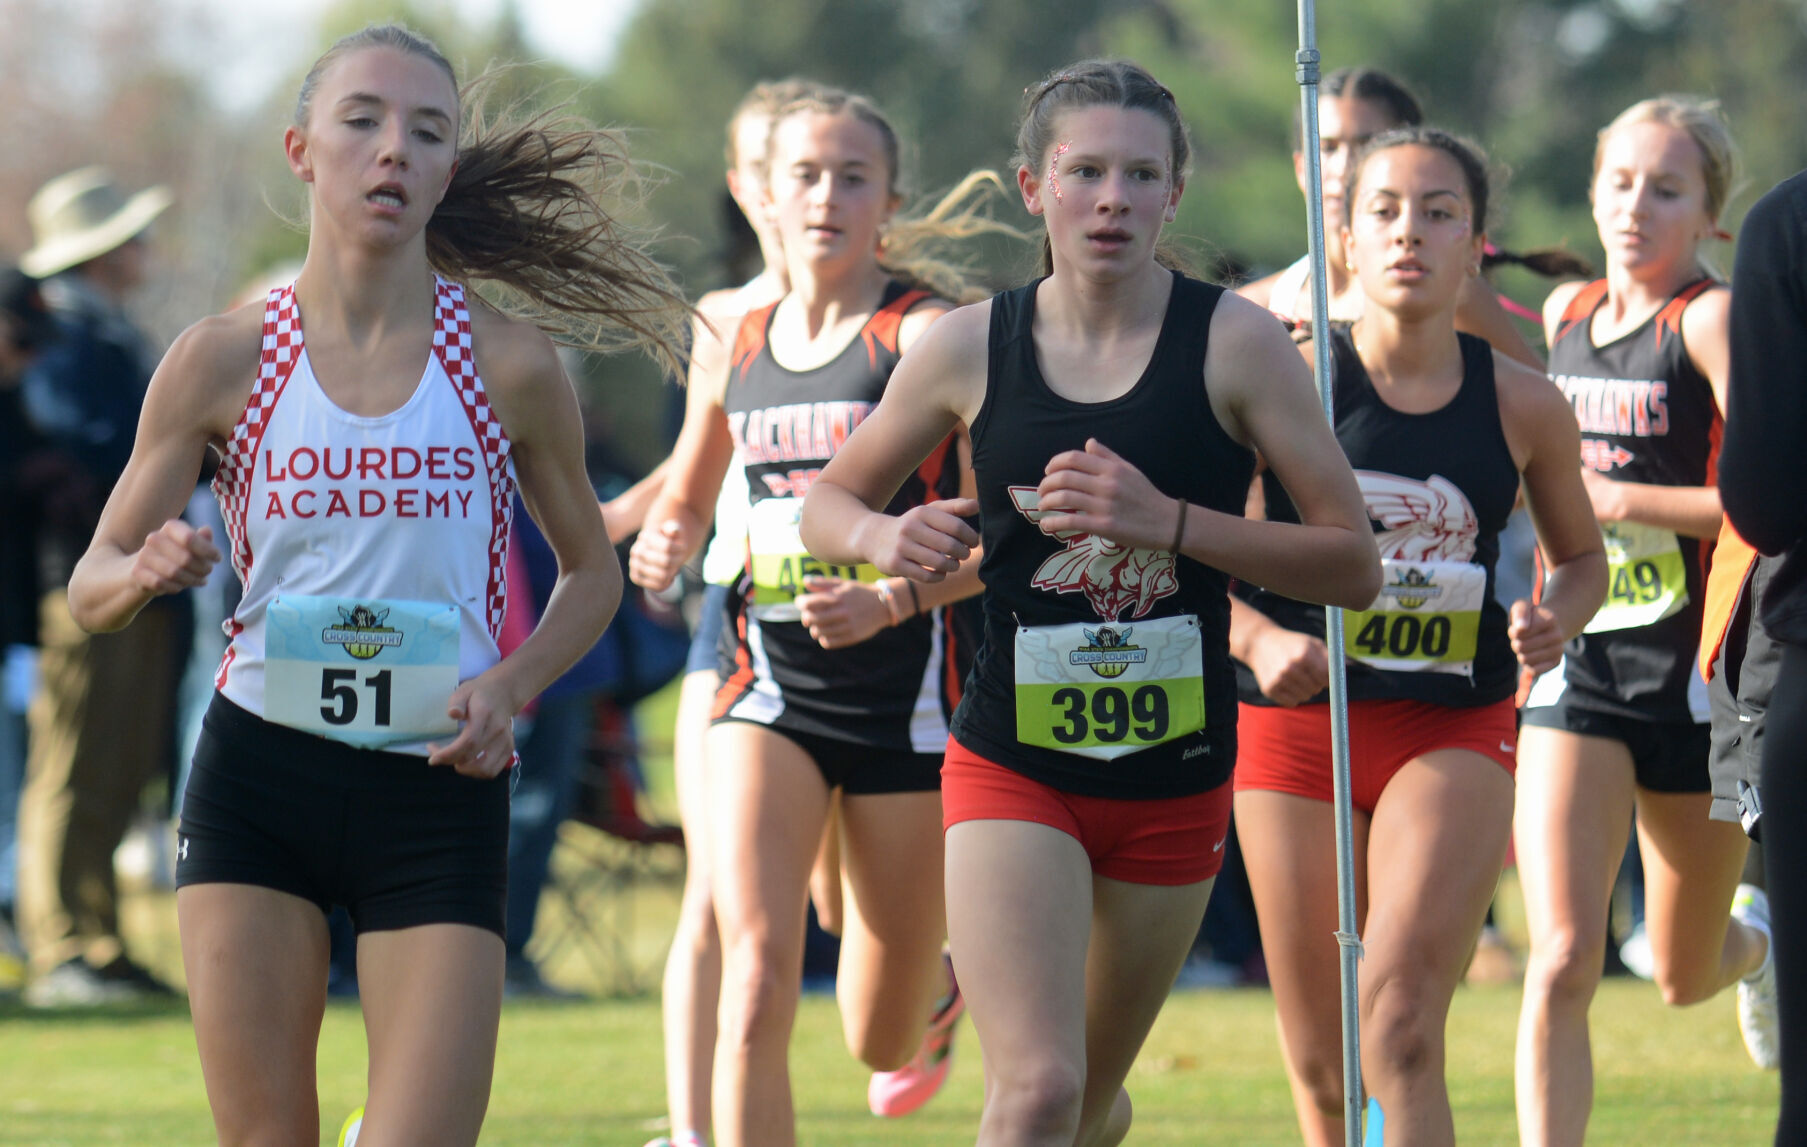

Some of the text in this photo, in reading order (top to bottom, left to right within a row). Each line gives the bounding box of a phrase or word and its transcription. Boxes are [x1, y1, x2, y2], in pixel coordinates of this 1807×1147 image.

[265, 447, 475, 482] LOURDES
[265, 489, 473, 520] ACADEMY
[779, 556, 859, 599] 45
[1604, 561, 1662, 605] 49
[324, 631, 402, 644] CROSS COUNTRY
[1071, 650, 1145, 663] CROSS COUNTRY
[1355, 614, 1451, 658] 400
[320, 667, 392, 727] 51
[1051, 684, 1170, 744] 399
